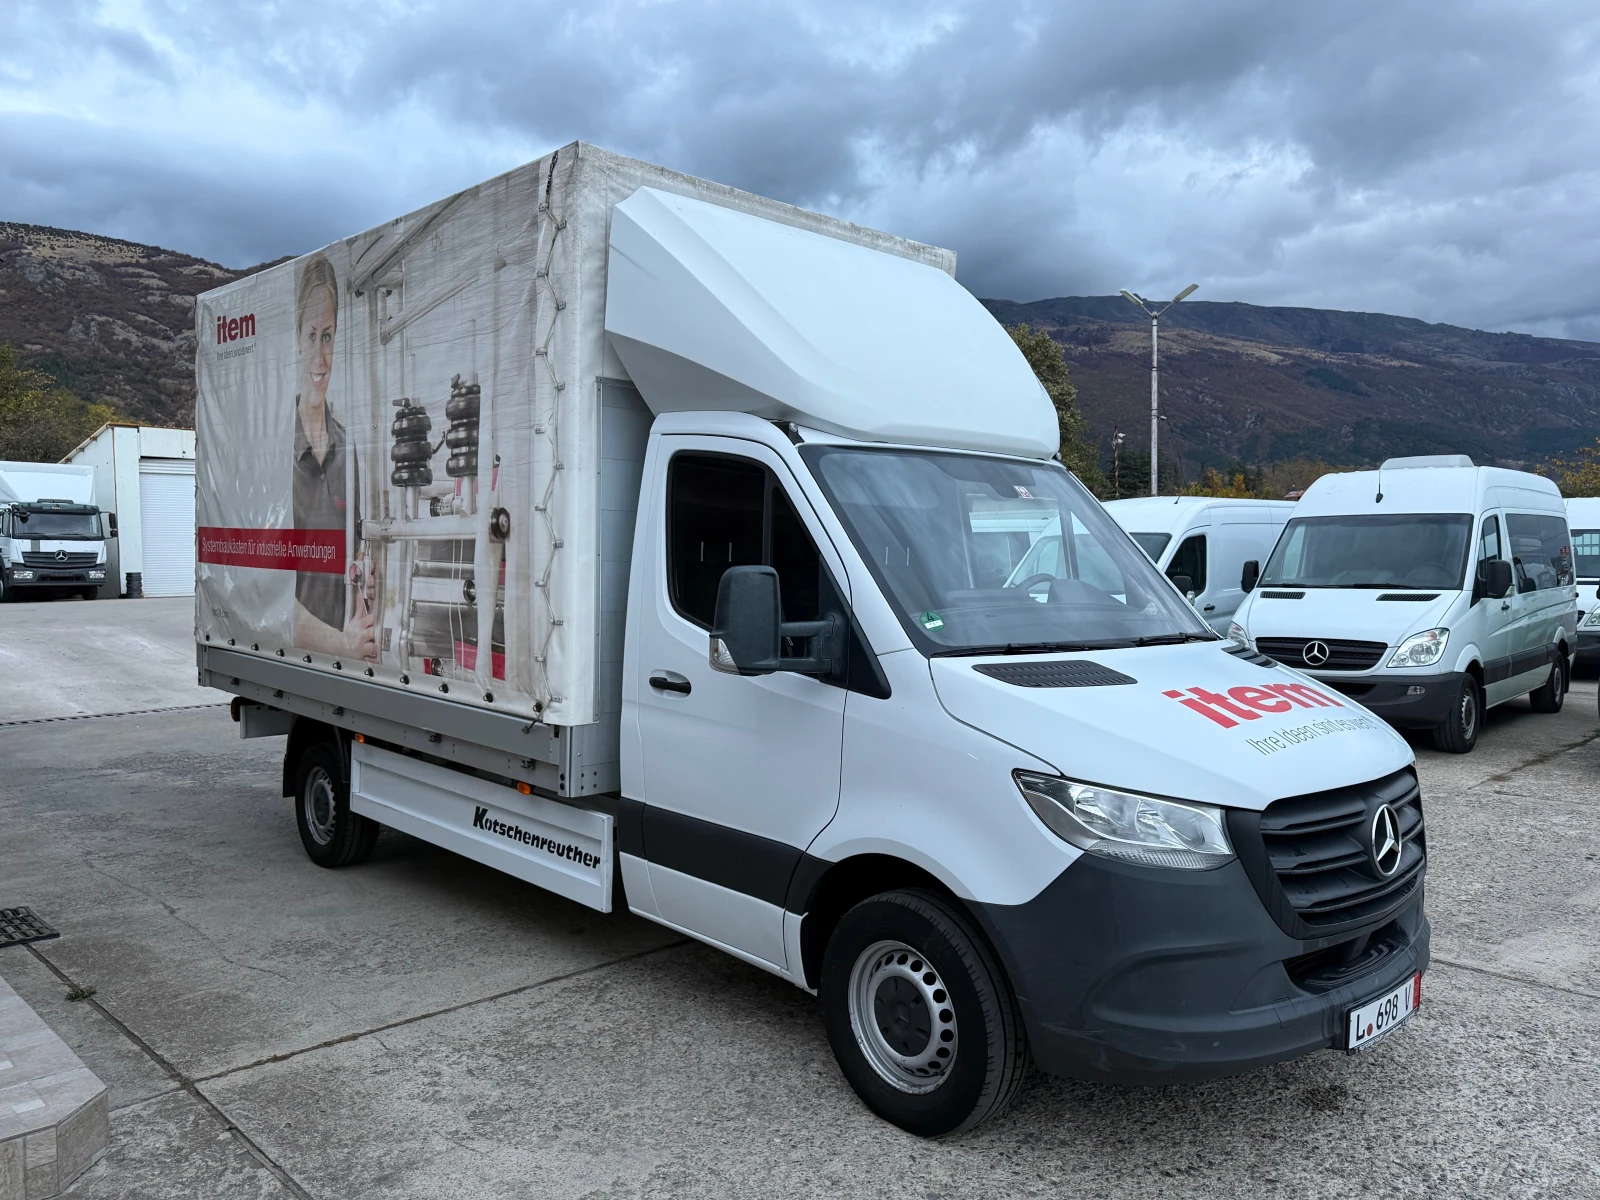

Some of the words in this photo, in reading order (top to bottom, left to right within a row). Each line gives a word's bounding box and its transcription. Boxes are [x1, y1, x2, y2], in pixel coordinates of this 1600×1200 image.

[217, 313, 255, 345] item
[202, 537, 247, 555] Systembaukästen
[248, 539, 256, 555] für
[256, 540, 287, 557] industrielle
[288, 541, 336, 562] Anwendungen
[1161, 683, 1346, 729] item
[1245, 736, 1286, 756] Ihre
[1273, 725, 1322, 745] Ideen
[1312, 718, 1344, 735] sind
[473, 806, 600, 869] Kotschenreuther
[1376, 994, 1398, 1030] 698
[1405, 984, 1411, 1011] V
